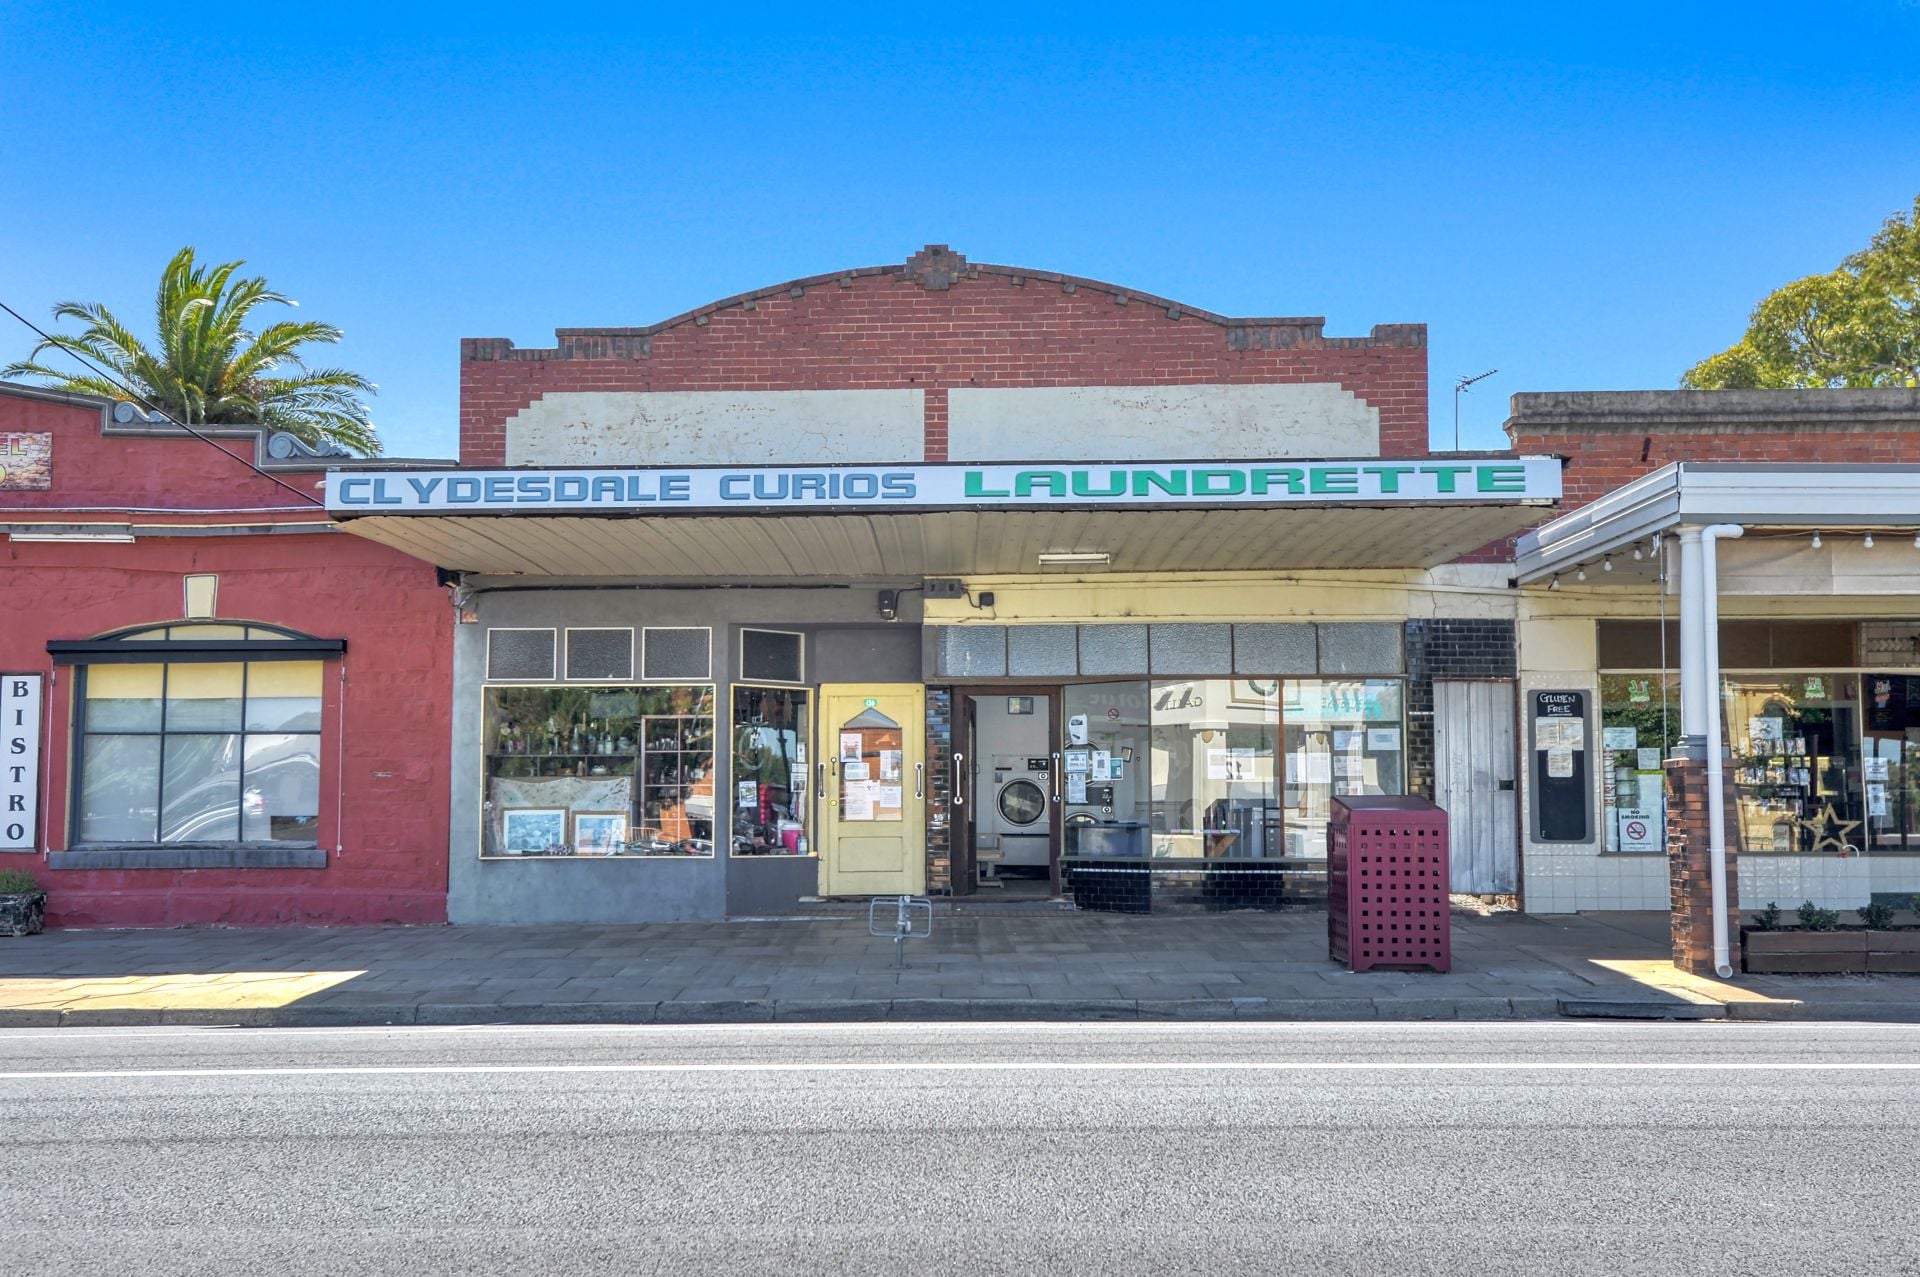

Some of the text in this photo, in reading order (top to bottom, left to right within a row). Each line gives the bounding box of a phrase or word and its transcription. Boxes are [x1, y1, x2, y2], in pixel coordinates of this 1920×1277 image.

[339, 472, 917, 505] CLYDESDALE CURIOS
[965, 466, 1526, 498] LAUNDRETTE
[1547, 704, 1571, 713] FREE
[6, 680, 29, 841] BISTRO
